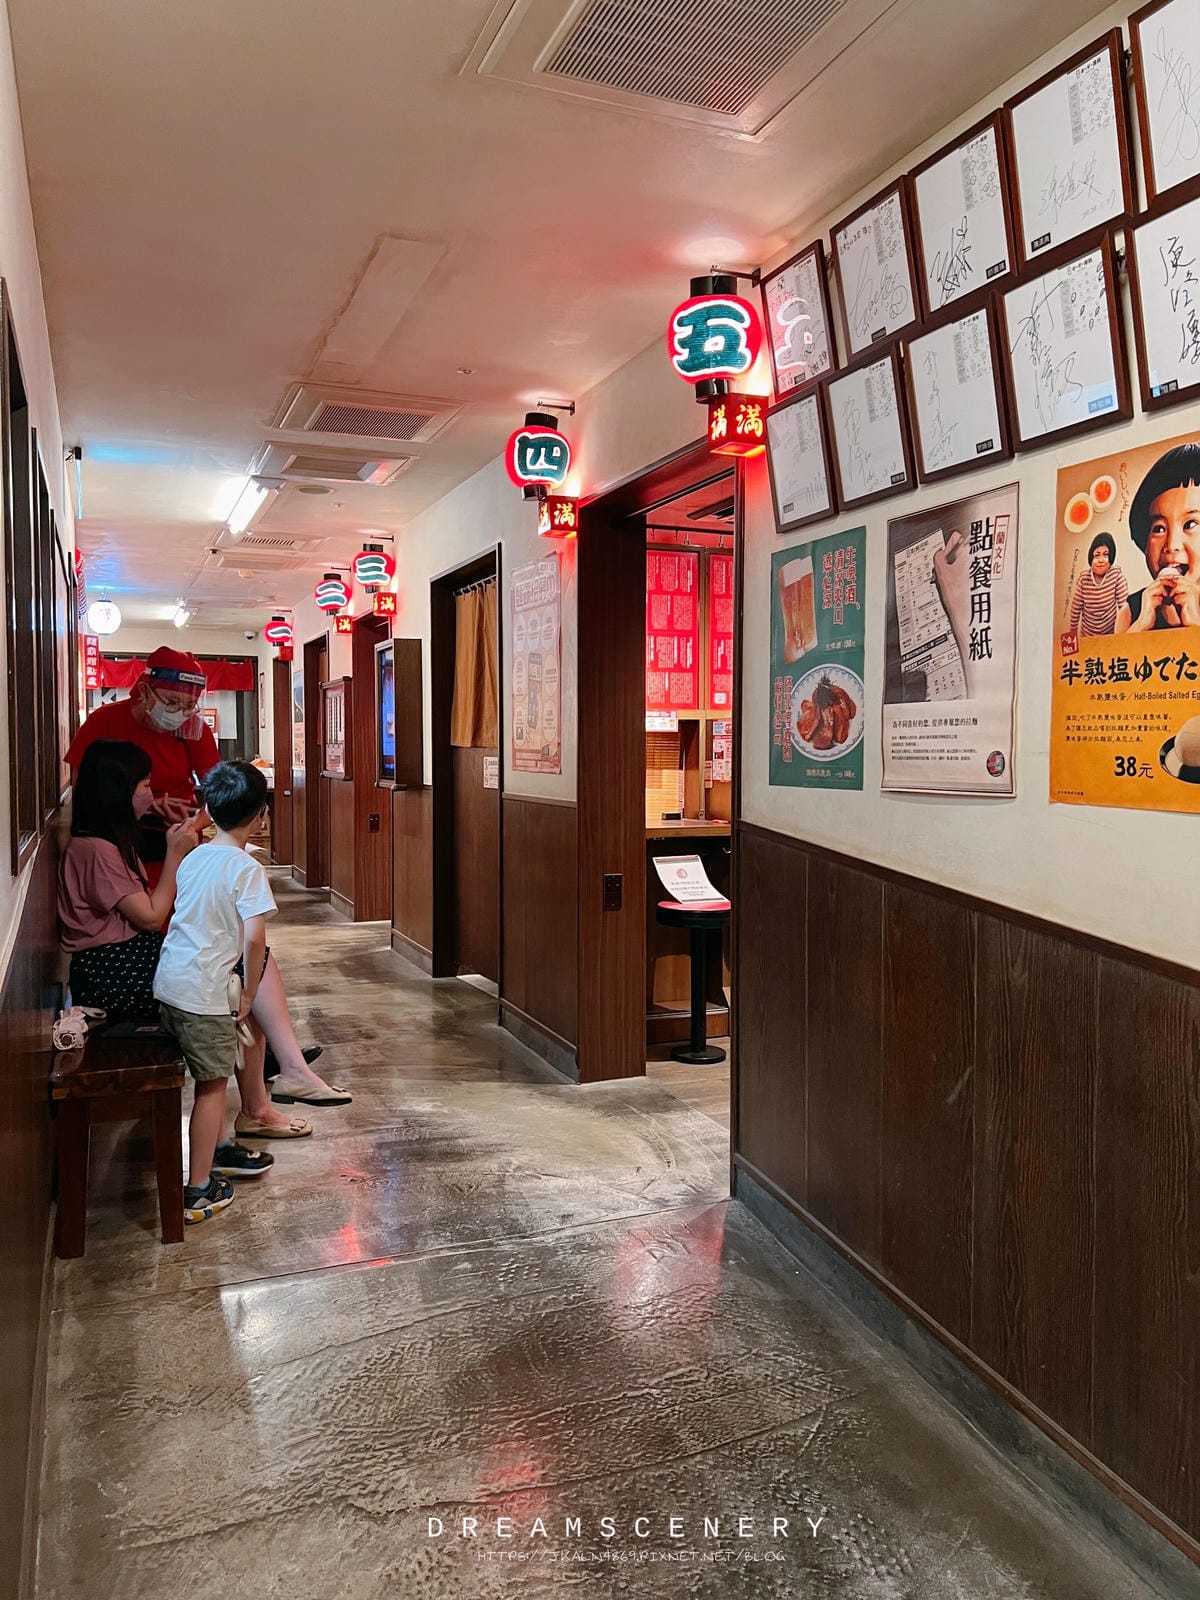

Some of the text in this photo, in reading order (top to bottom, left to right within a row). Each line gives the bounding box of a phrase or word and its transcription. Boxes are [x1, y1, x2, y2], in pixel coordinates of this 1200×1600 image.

[674, 301, 750, 375] 五
[516, 433, 570, 480] 四
[993, 524, 1007, 575] 一蘭文化
[356, 555, 390, 583] 三
[316, 582, 347, 606] 二
[968, 517, 994, 662] 點餐用紙
[267, 626, 292, 638] 一
[1060, 652, 1199, 686] 半熟塩ゆでた
[1134, 692, 1167, 700] Half-Boiled
[1168, 690, 1189, 699] Salted
[1114, 755, 1155, 779] 38元
